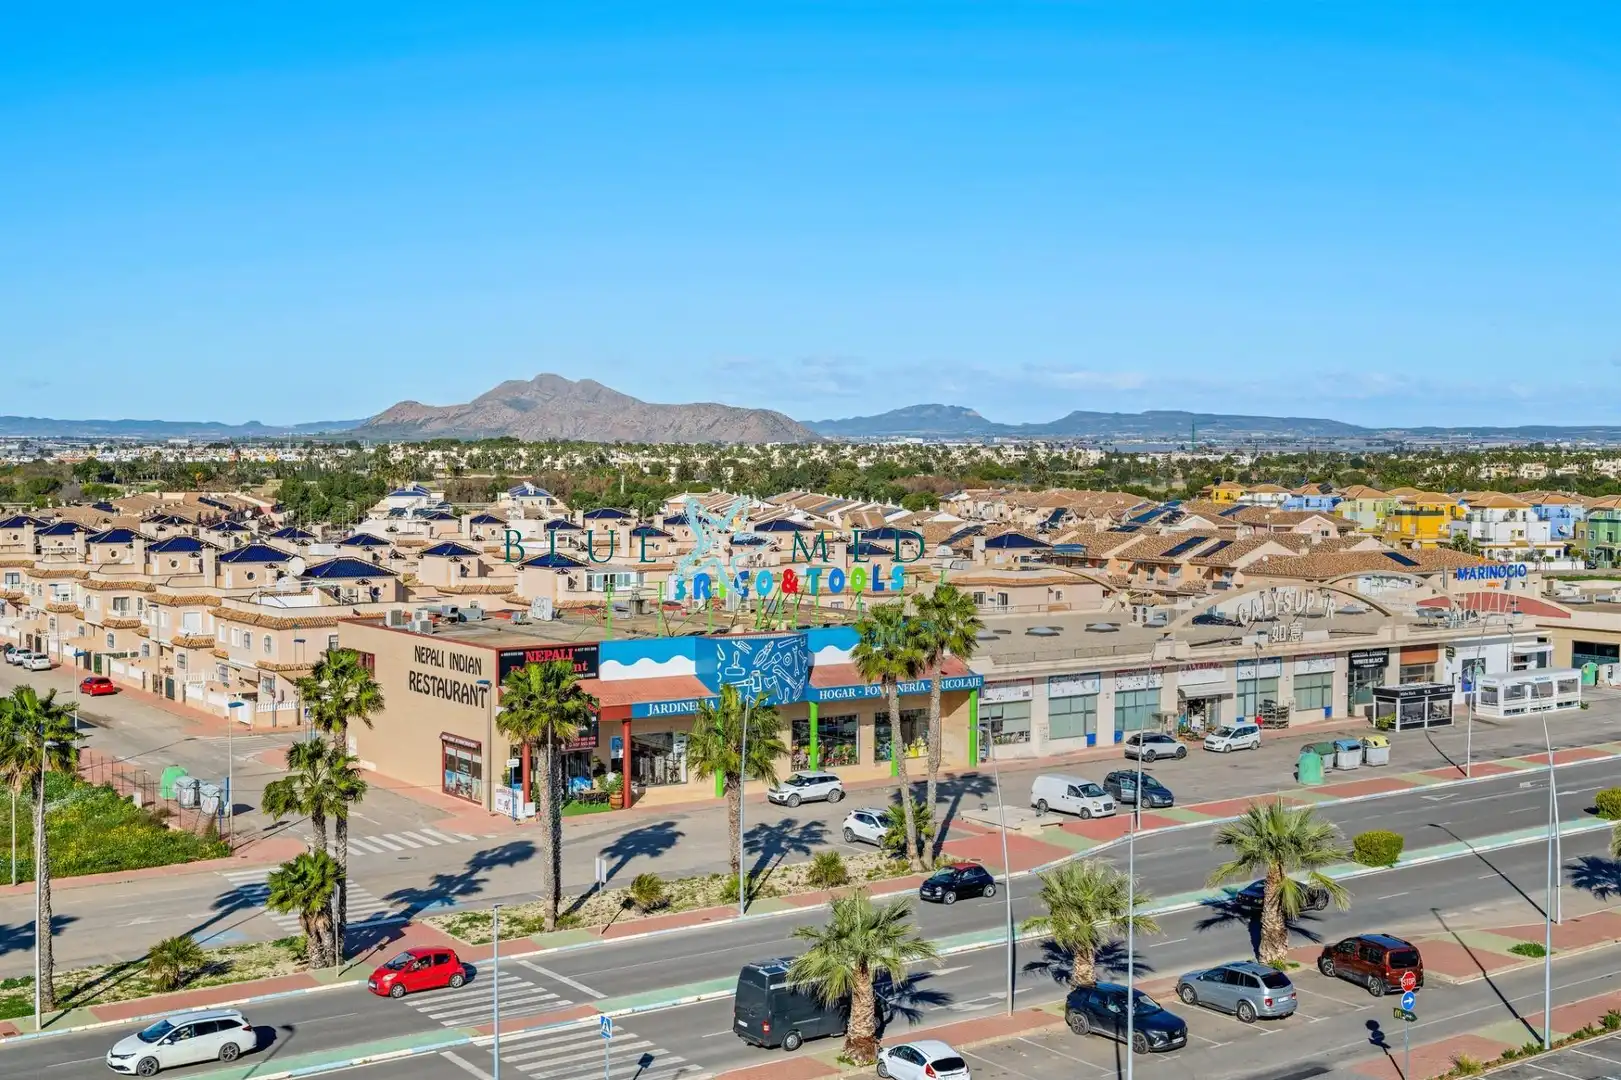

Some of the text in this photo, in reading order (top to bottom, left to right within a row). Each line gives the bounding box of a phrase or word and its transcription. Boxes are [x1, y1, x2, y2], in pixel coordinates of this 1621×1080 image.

[1456, 564, 1527, 580] MARINOCIO
[1238, 588, 1336, 625] GALYSUPR
[414, 645, 445, 668] NEPALI
[450, 651, 482, 676] INDIAN
[525, 648, 574, 663] NEPALI
[409, 671, 487, 709] RESTAURANT
[819, 676, 982, 700] HOGAR FONNERÍA RICOLAJE
[1403, 978, 1416, 986] STOP
